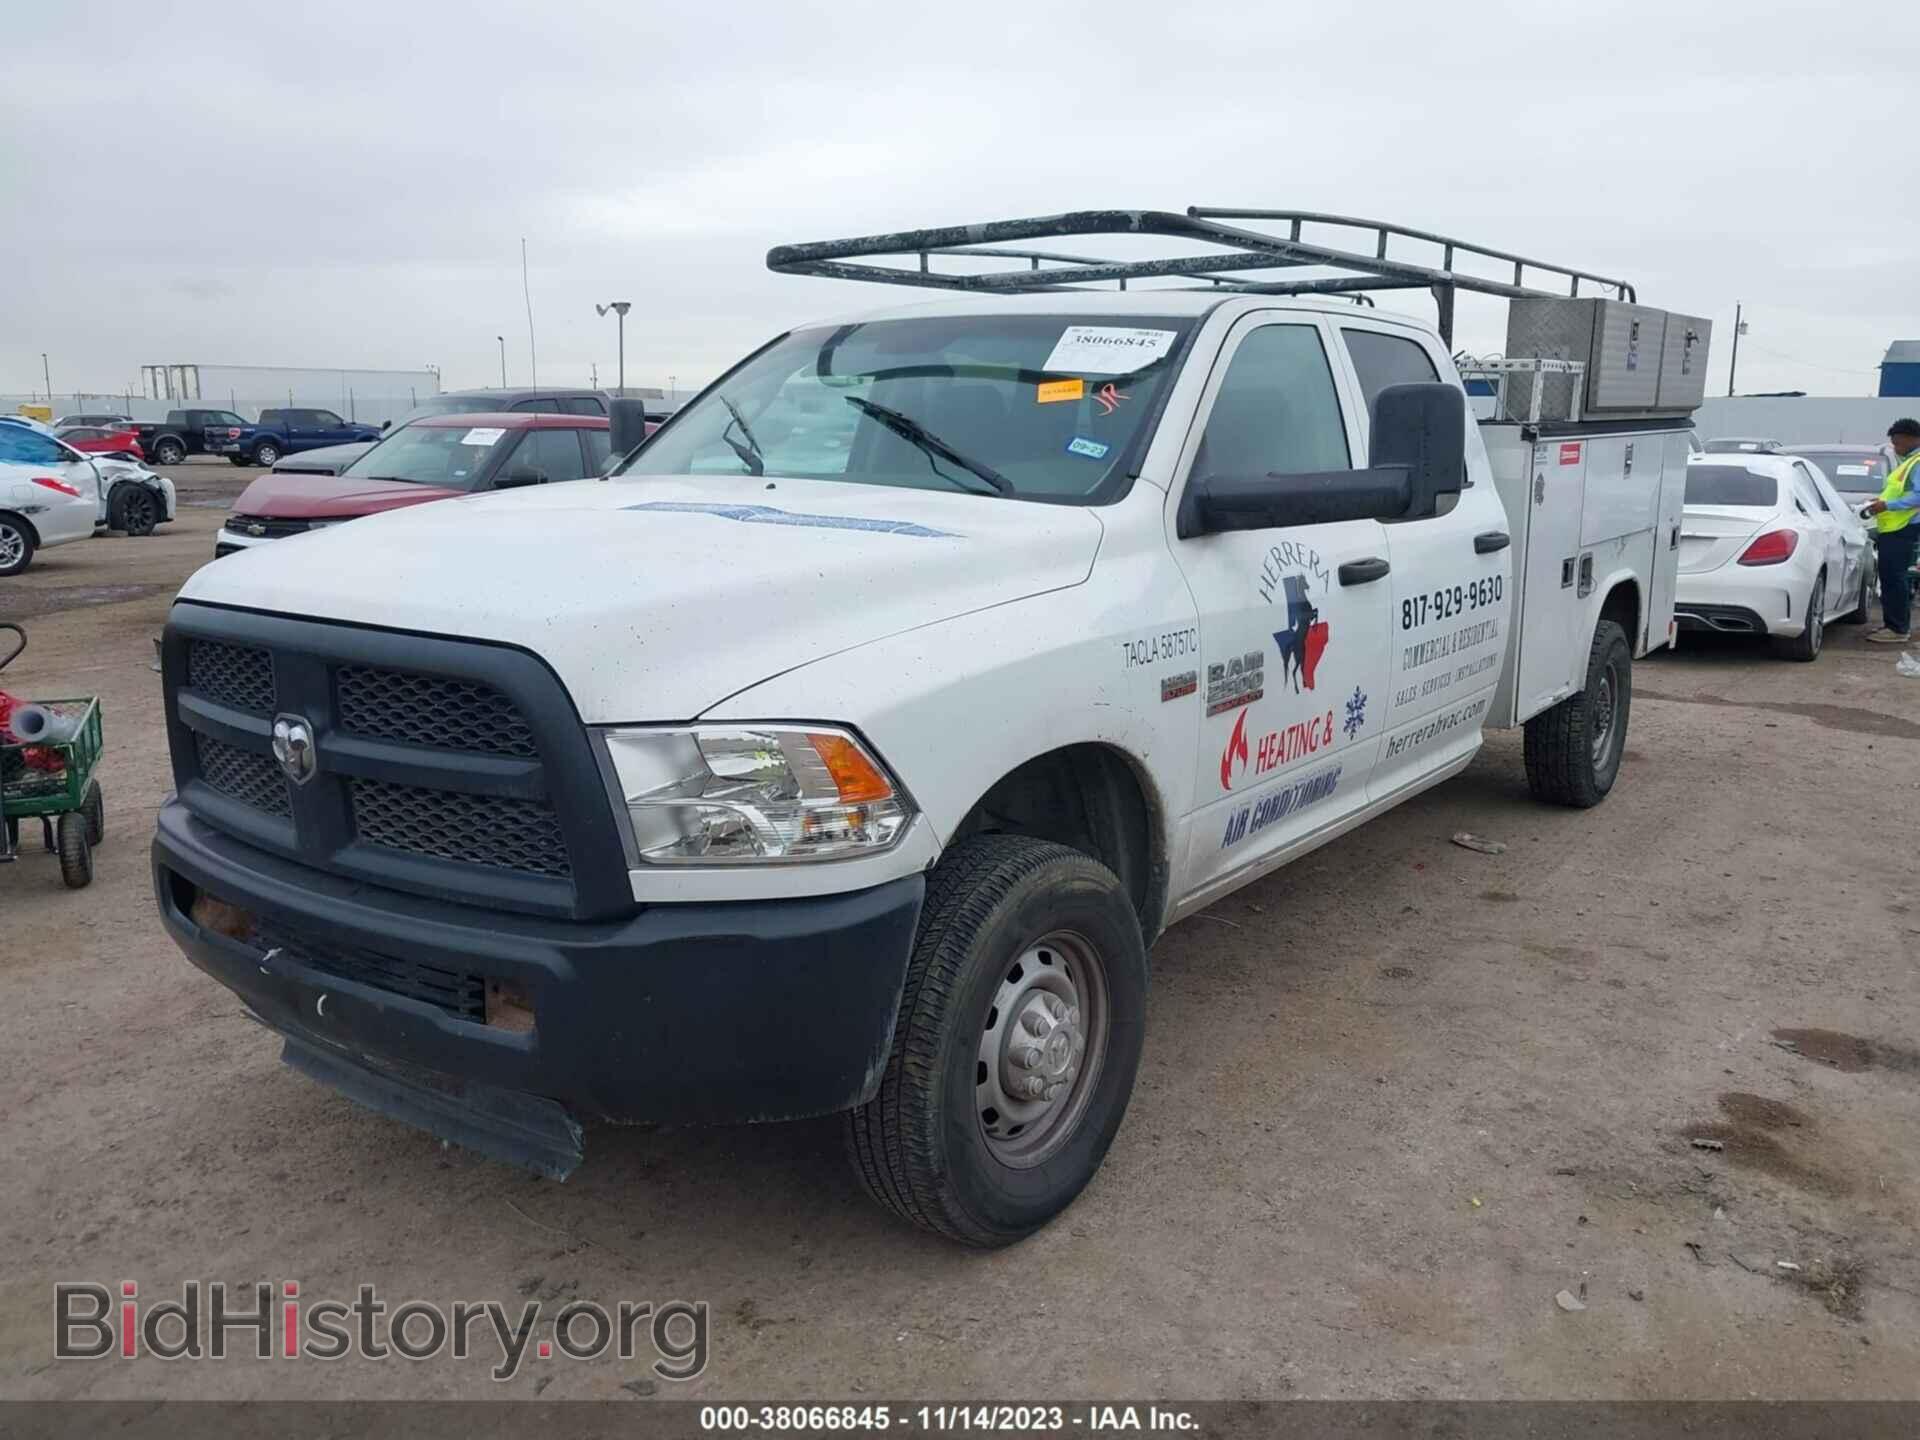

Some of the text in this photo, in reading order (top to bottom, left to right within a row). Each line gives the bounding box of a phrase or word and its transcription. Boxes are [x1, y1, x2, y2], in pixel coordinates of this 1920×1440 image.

[1258, 541, 1329, 604] HERRERA
[1402, 574, 1503, 630] 817-929-9630
[1123, 628, 1198, 668] TACLA 58757C
[1255, 710, 1333, 775] HEATING &
[1386, 699, 1486, 760] herrerahvac.com
[1221, 765, 1343, 849] AIR CONDITIONING
